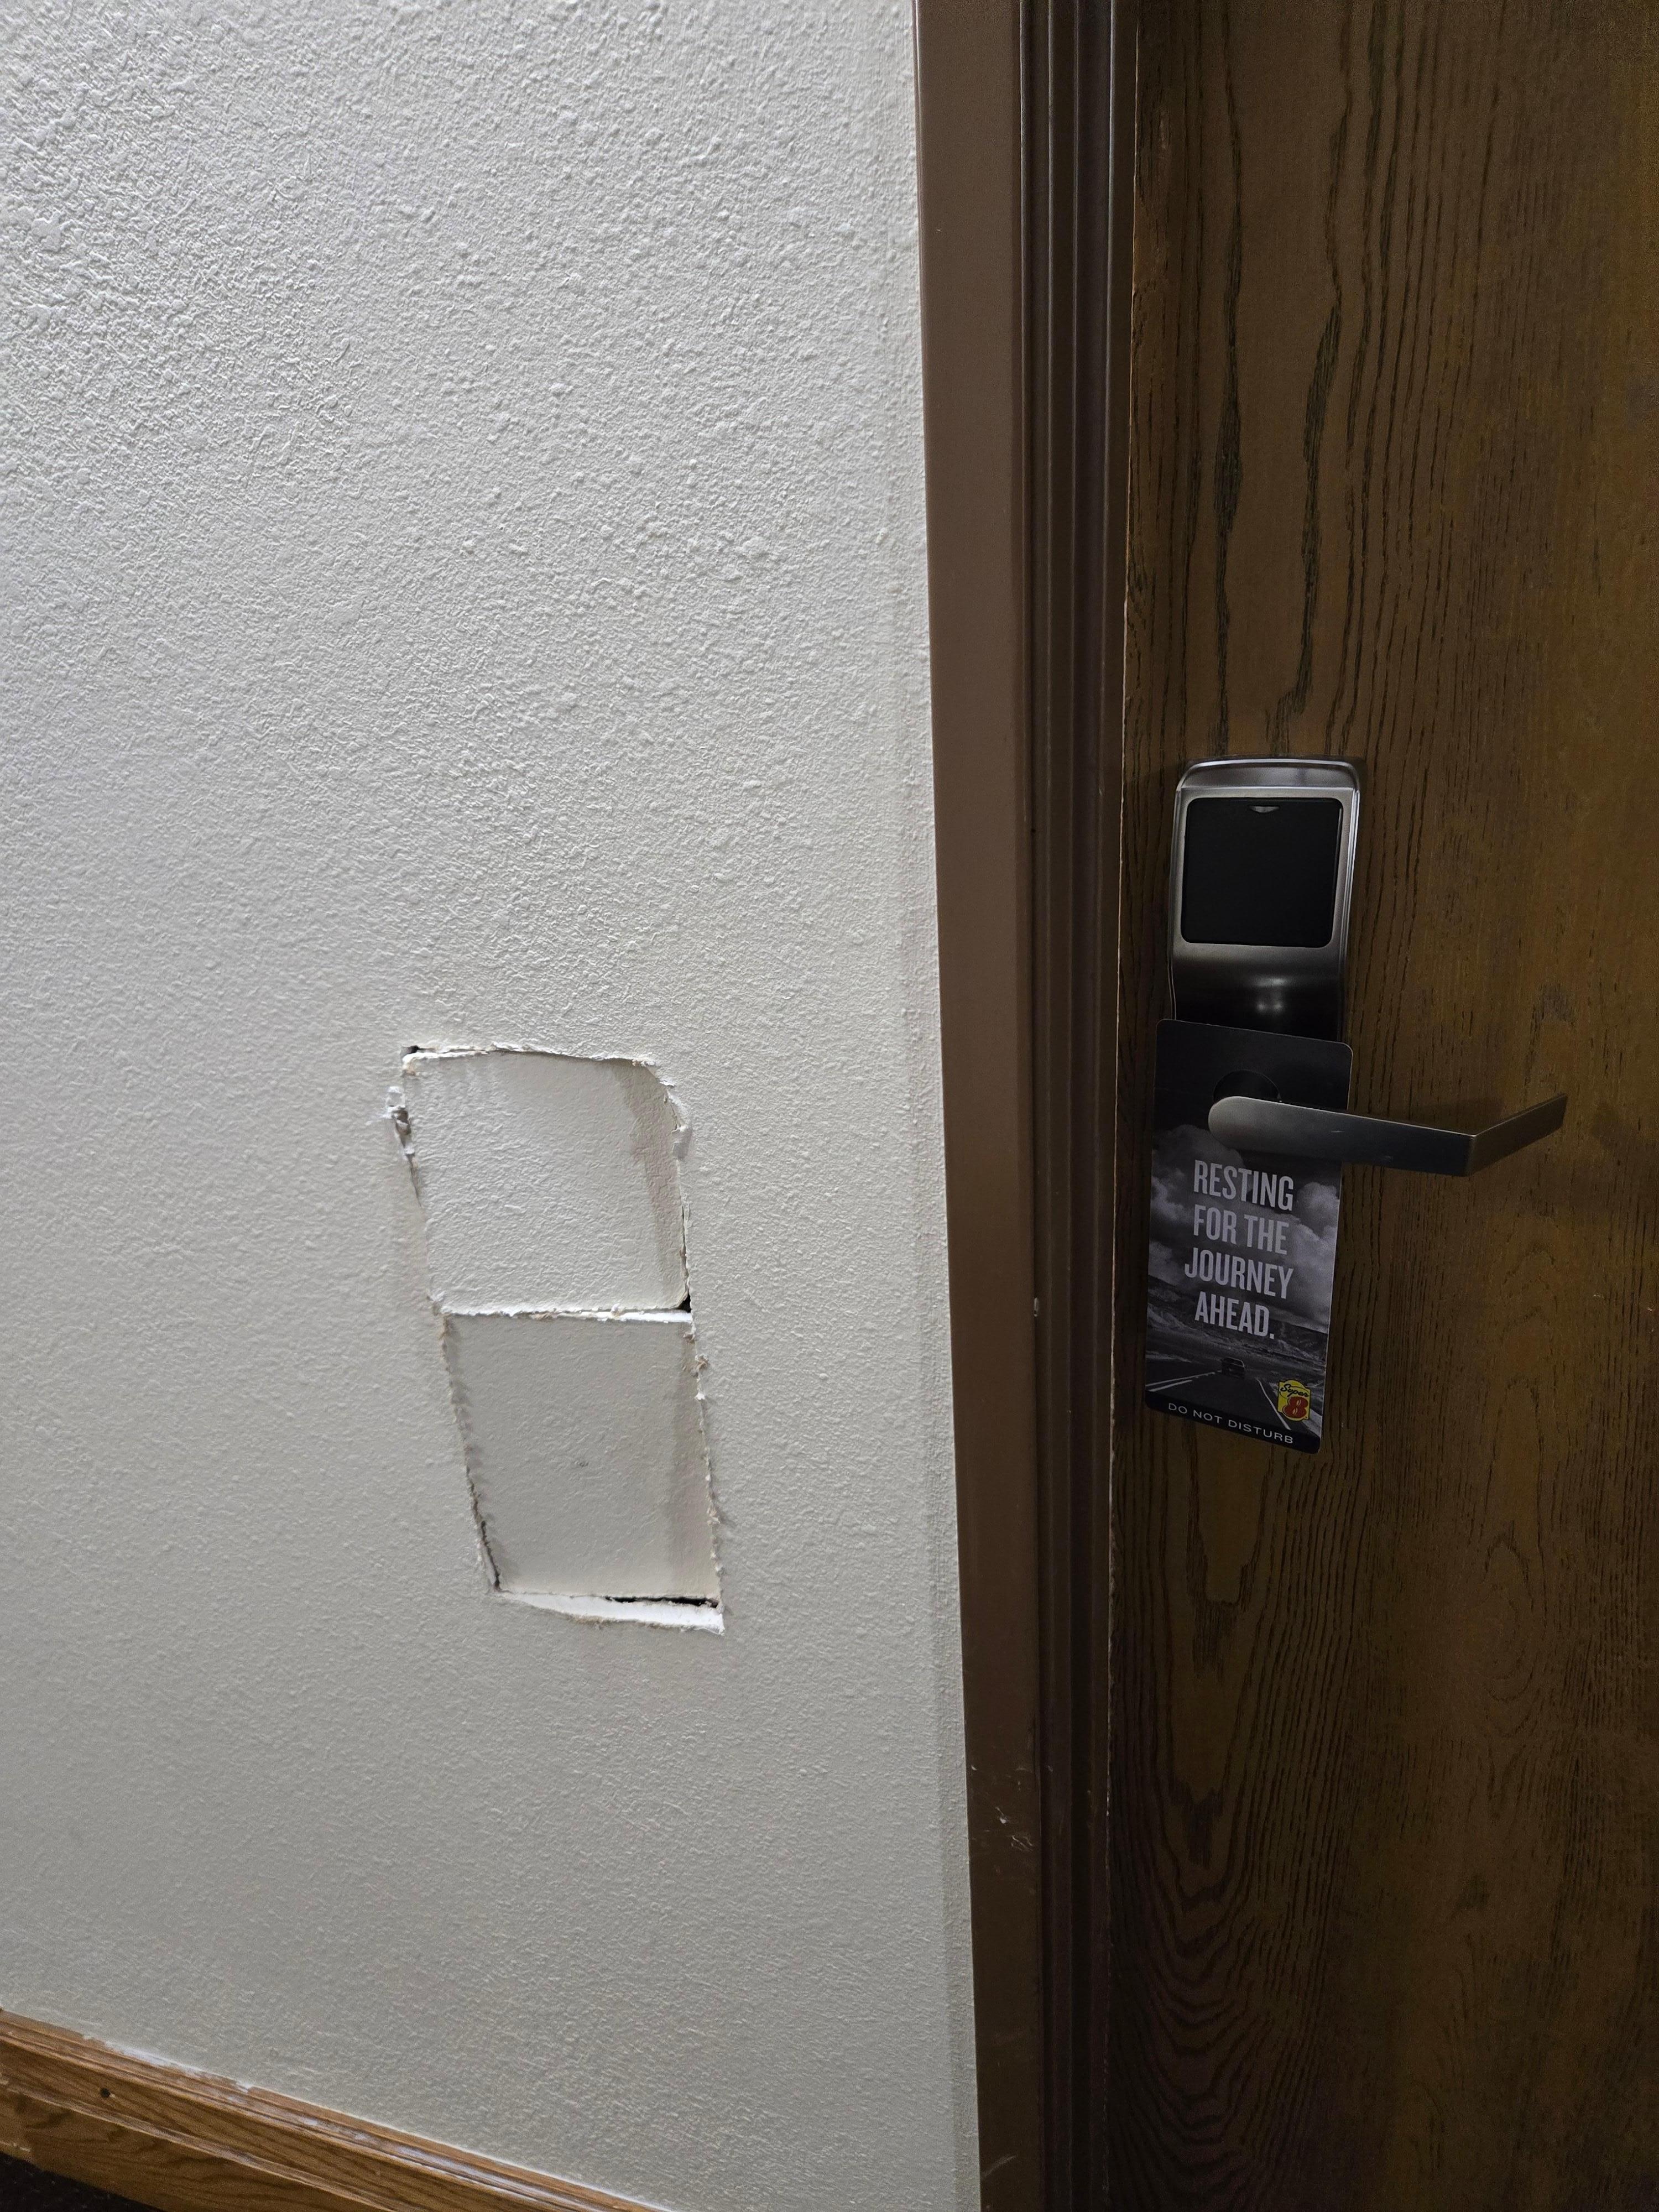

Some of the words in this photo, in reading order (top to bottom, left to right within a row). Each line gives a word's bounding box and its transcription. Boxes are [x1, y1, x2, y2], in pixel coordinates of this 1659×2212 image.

[1193, 1160, 1294, 1211] RESTING
[1193, 1204, 1237, 1244] FOR
[1244, 1214, 1290, 1255] THE
[1185, 1247, 1294, 1299] JOURNEY
[1194, 1291, 1275, 1339] AHEAD.
[1280, 1383, 1310, 1397] Super
[1282, 1396, 1308, 1418] 8
[1168, 1402, 1188, 1414] DO
[1193, 1410, 1223, 1424] NOT
[1228, 1420, 1293, 1444] DISTURB
